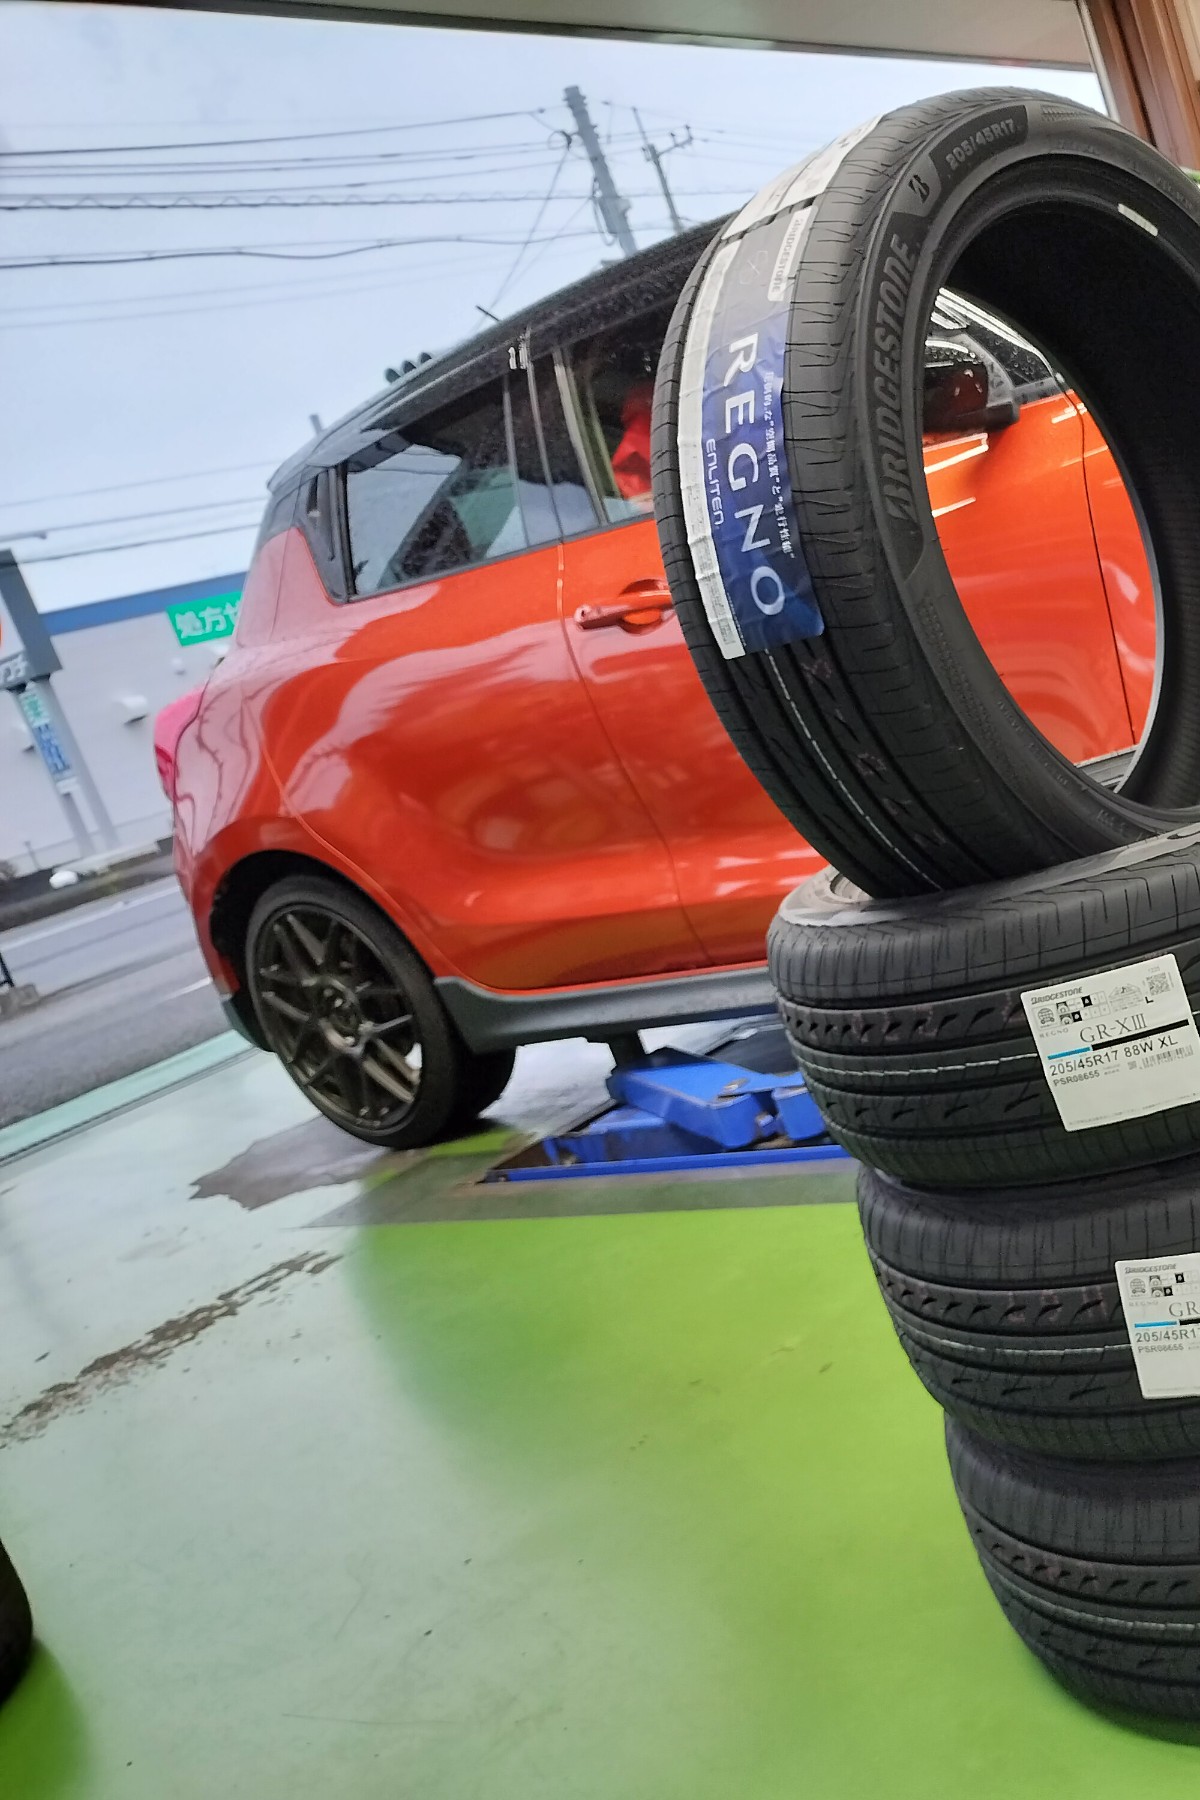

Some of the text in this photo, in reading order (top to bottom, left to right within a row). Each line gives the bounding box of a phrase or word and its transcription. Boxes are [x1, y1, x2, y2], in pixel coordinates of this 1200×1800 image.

[945, 118, 1017, 171] 205/45R17
[874, 233, 916, 520] BRIDGESTONE
[705, 438, 725, 526] ENLITEN
[724, 333, 785, 616] REGNO
[1031, 986, 1083, 1005] BRIDGESTONE
[1050, 1049, 1119, 1077] 205/45R17
[1124, 1039, 1153, 1058] 88W
[1159, 1034, 1178, 1049] XL
